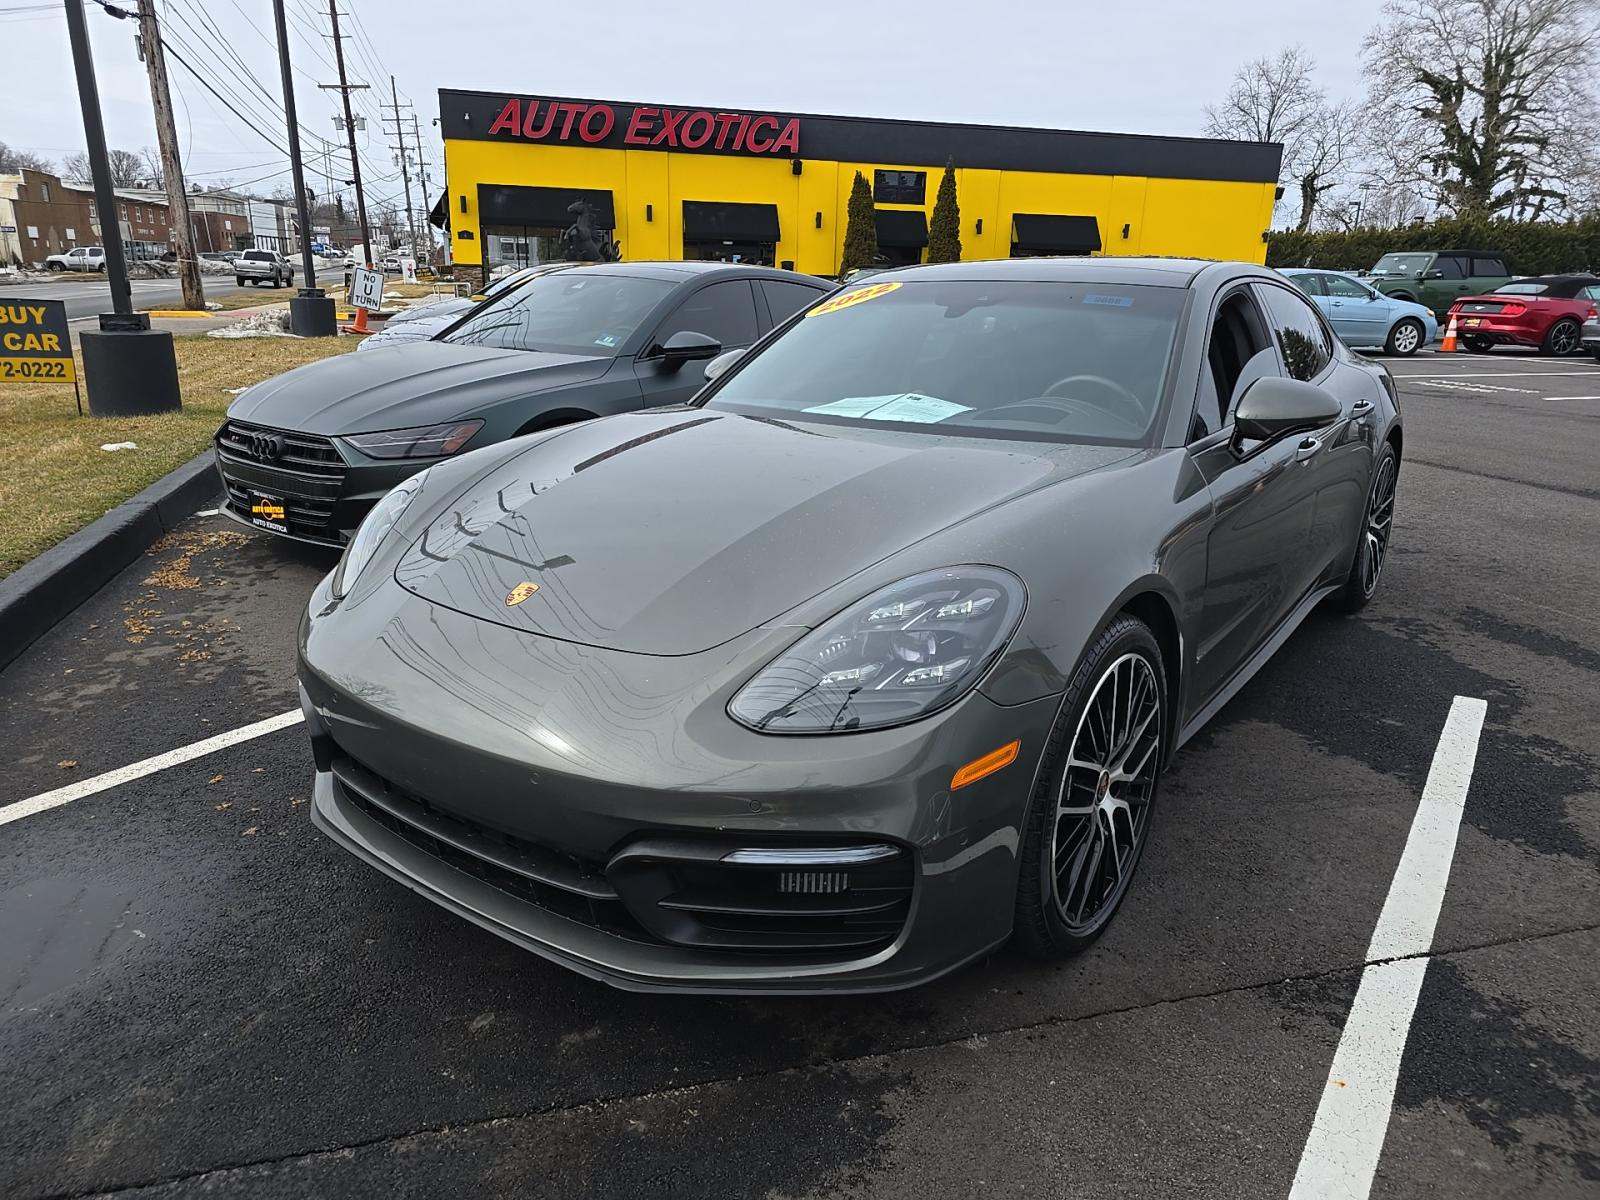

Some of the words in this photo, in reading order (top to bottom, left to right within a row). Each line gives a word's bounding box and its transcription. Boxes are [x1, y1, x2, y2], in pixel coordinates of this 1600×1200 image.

[488, 98, 615, 143] AUTO
[624, 106, 801, 154] EXOTICA
[363, 273, 376, 283] NO
[364, 284, 373, 295] U
[818, 283, 894, 313] 2022
[355, 295, 379, 307] TURN
[3, 332, 61, 352] CAR
[0, 361, 66, 378] 2-0222
